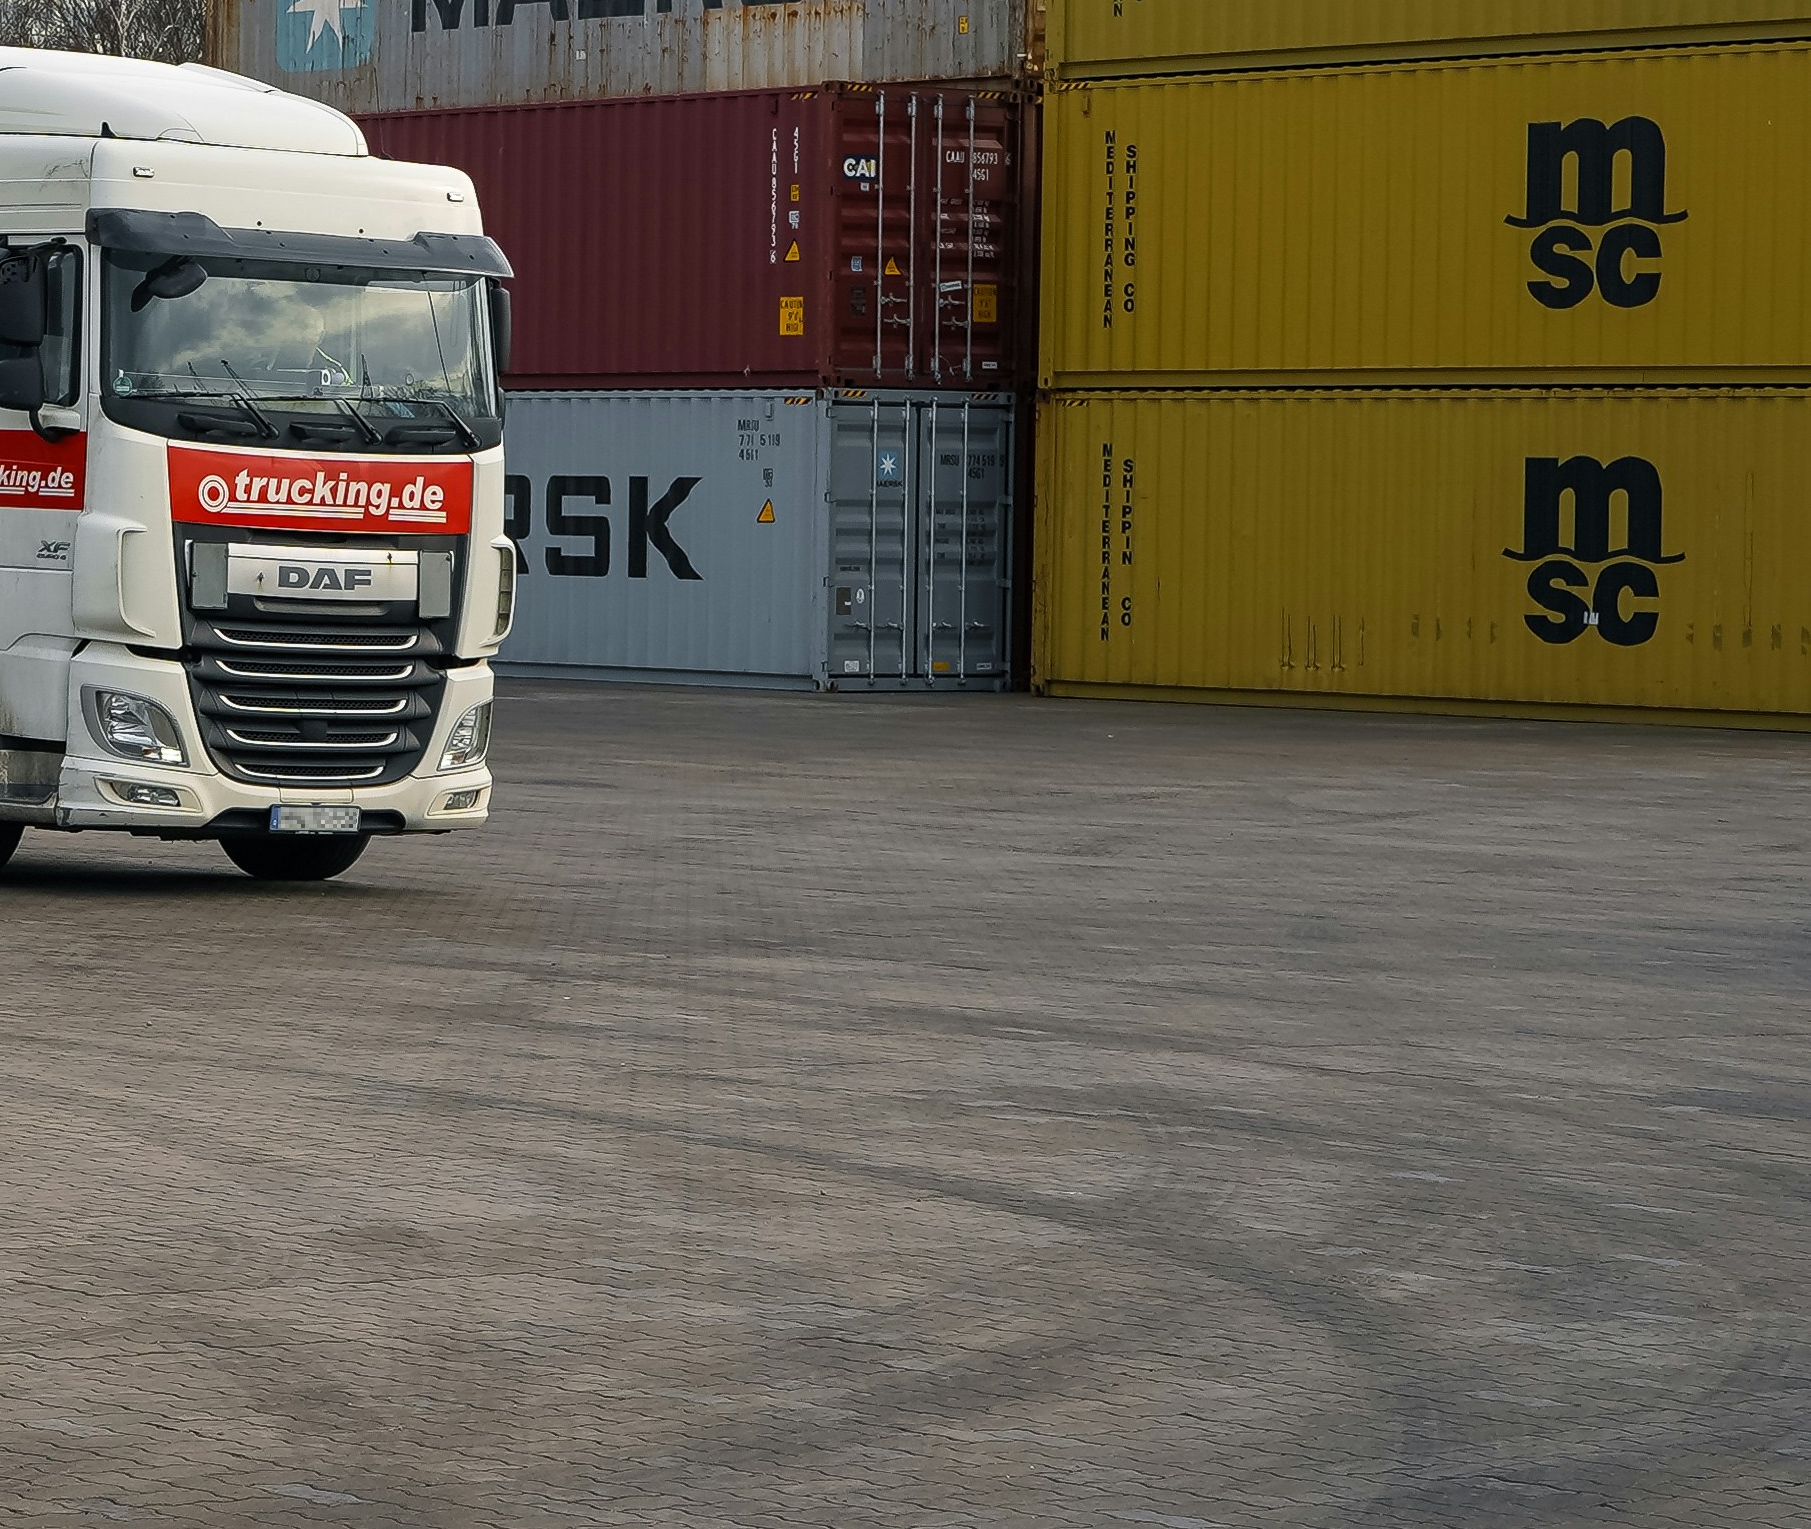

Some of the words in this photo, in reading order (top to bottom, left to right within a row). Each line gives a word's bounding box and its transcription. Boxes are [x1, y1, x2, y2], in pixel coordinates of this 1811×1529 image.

[843, 158, 876, 178] CAI
[1124, 144, 1137, 267] SHIPPING
[1123, 283, 1136, 313] CO
[234, 467, 445, 516] trucking.de
[37, 540, 71, 553] XF
[278, 565, 372, 591] DAF
[1121, 596, 1133, 627] CO
